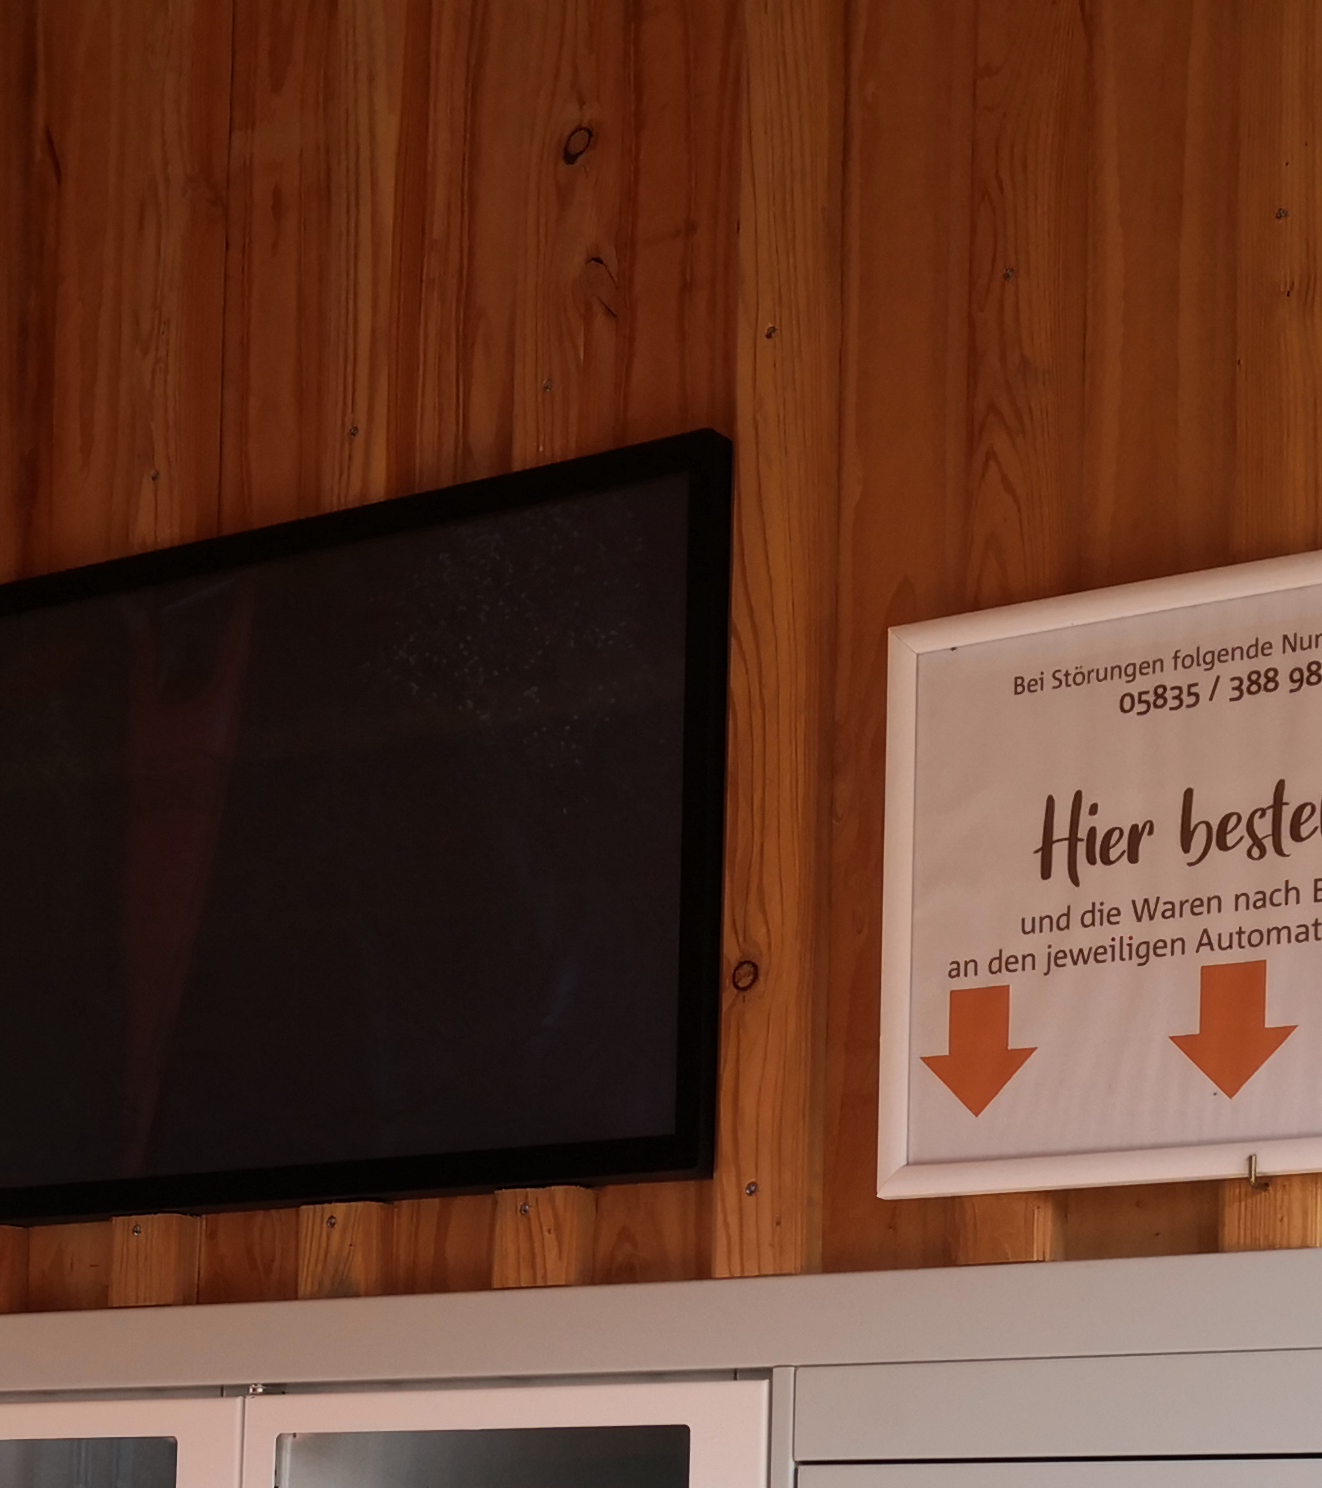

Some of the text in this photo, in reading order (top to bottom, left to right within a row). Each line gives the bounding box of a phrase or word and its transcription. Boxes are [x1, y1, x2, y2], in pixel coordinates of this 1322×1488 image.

[1013, 671, 1044, 695] Bei
[1051, 658, 1164, 690] Störungen
[1172, 637, 1273, 671] folgende
[1119, 682, 1200, 715] 05835
[1208, 675, 1220, 702] /
[1229, 667, 1280, 702] 388
[1288, 660, 1322, 693] 98
[1033, 790, 1155, 887] Hier
[1020, 904, 1071, 935] und
[1079, 901, 1122, 929] die
[1130, 895, 1222, 923] Waren
[1233, 879, 1301, 912] nach
[947, 958, 978, 979] an
[987, 948, 1036, 975] den
[1043, 934, 1186, 977] jeweiligen
